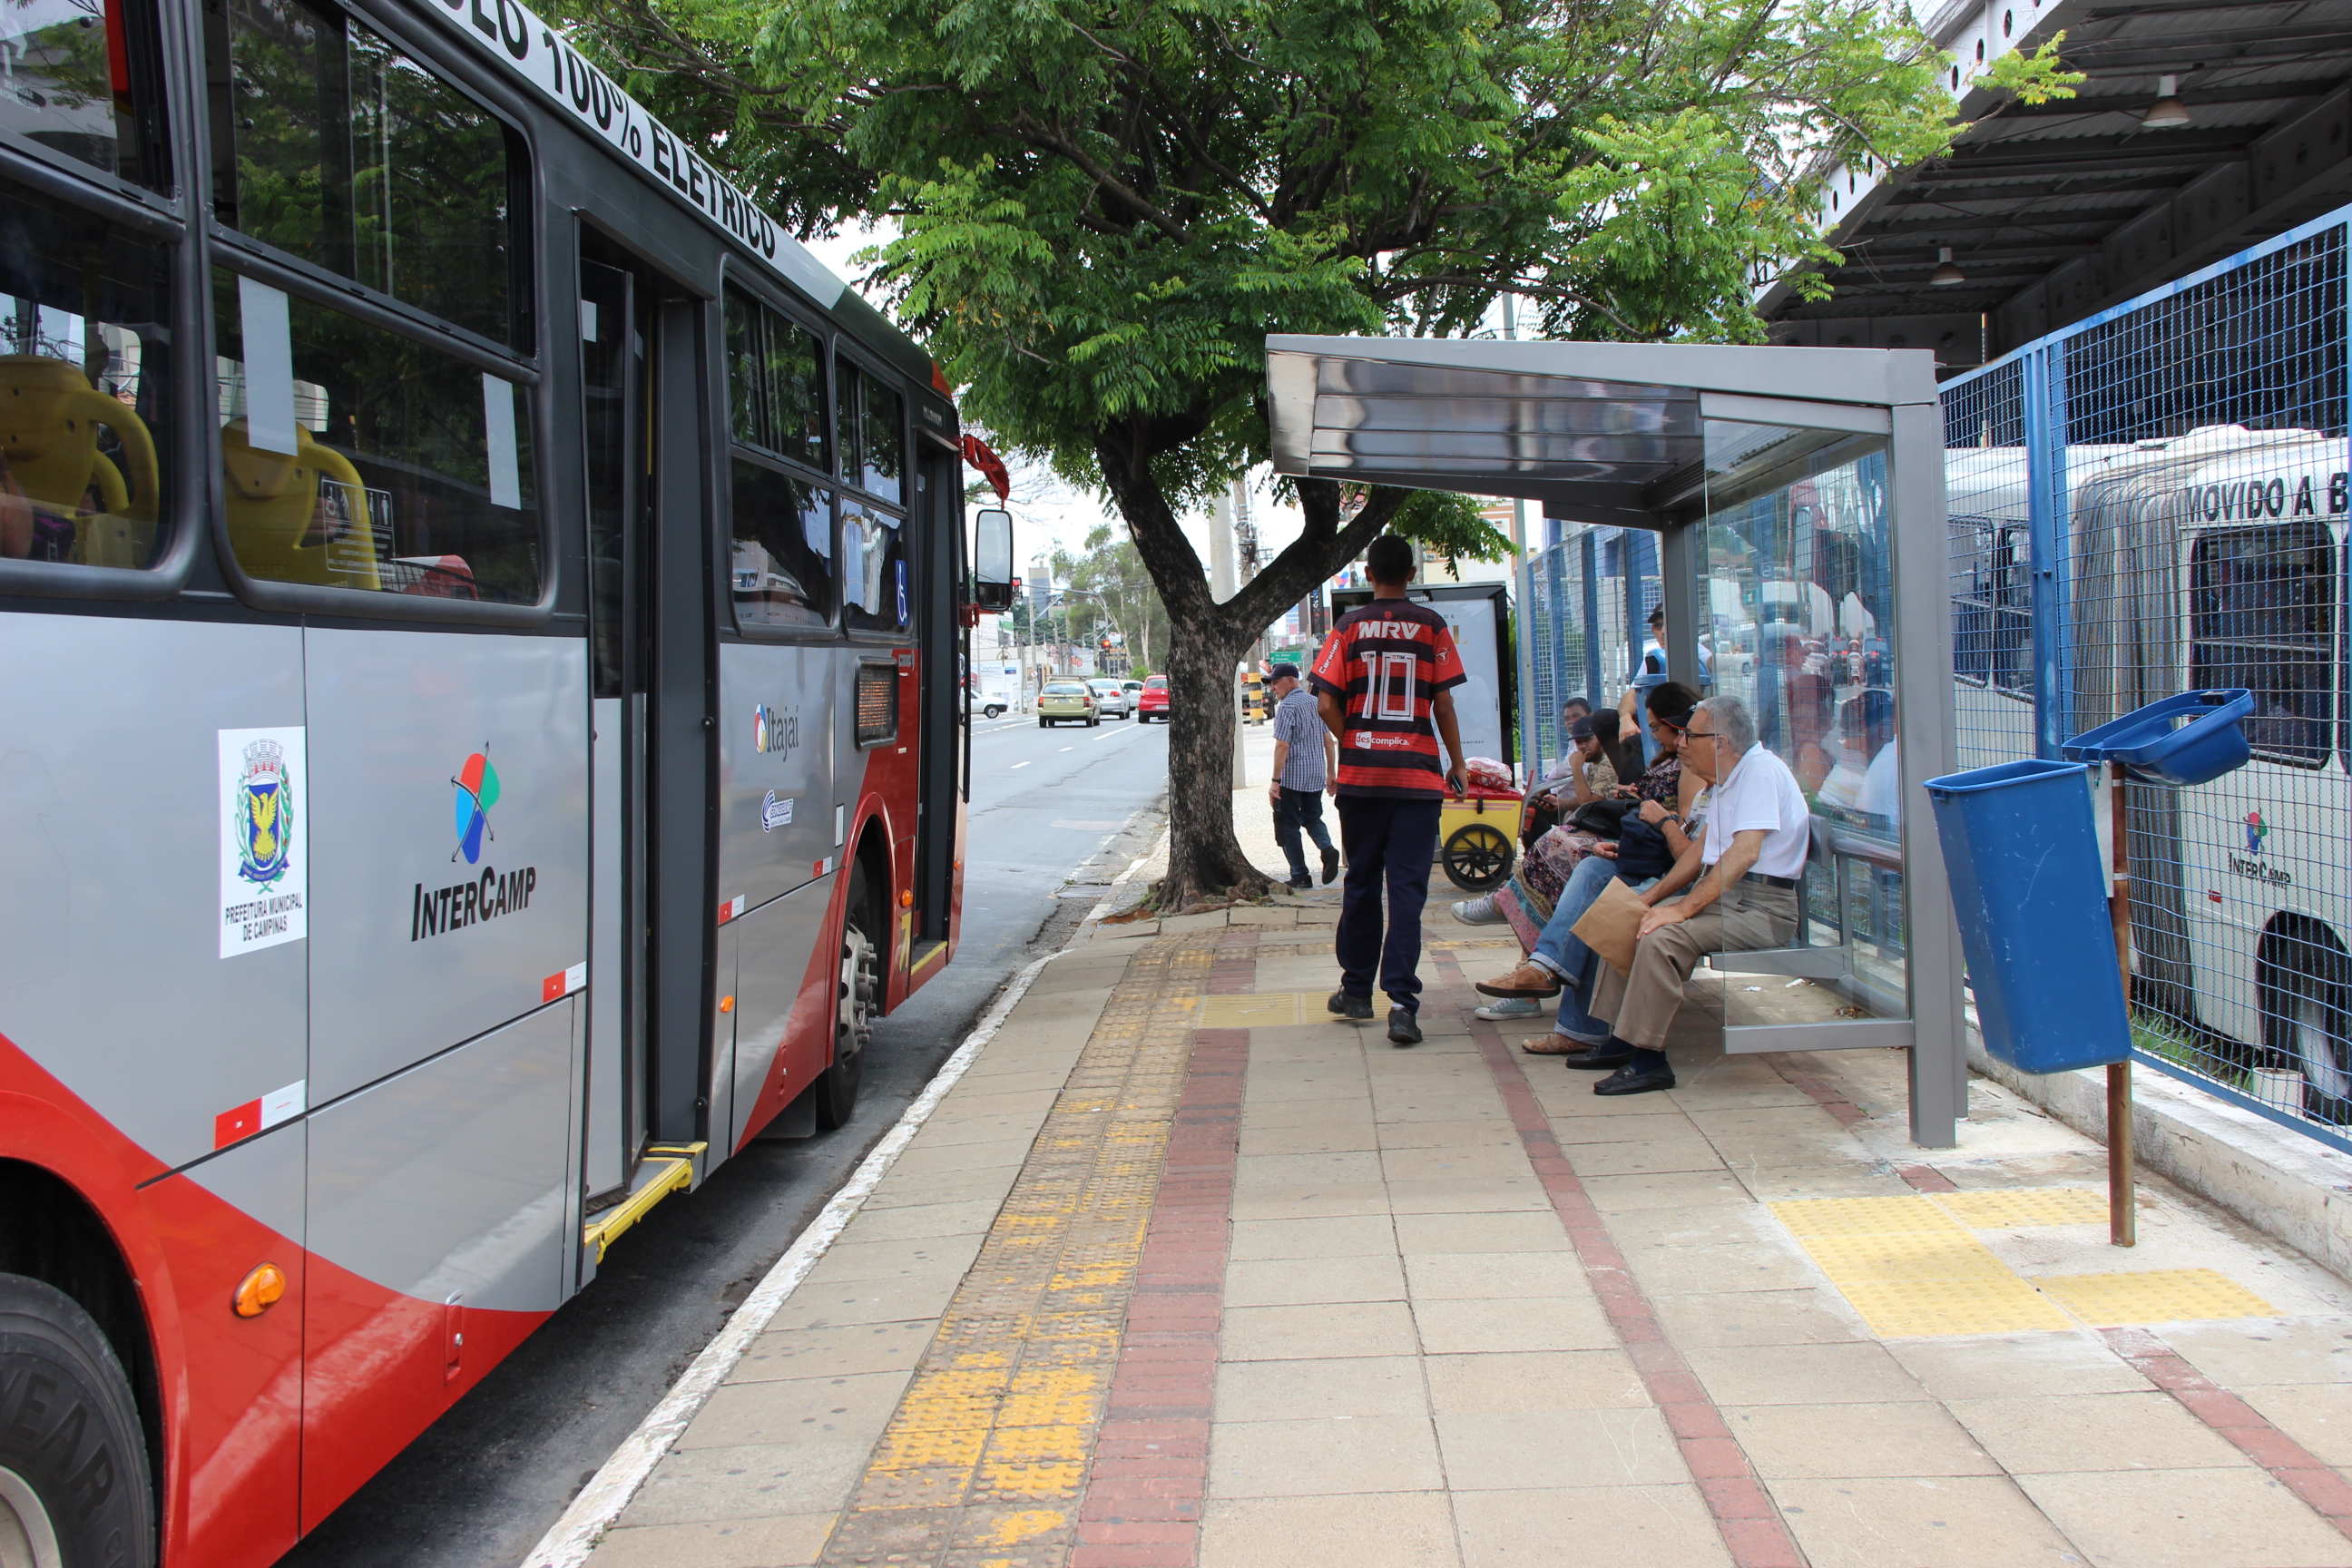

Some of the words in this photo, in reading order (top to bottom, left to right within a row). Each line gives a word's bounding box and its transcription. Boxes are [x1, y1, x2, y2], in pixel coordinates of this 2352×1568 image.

[544, 26, 642, 159] 100%
[648, 115, 776, 260] ELETRICO
[2184, 477, 2284, 523] MOVIDO
[2293, 475, 2314, 515] A
[1358, 621, 1422, 640] MRV
[1360, 651, 1416, 722] 10
[766, 704, 799, 763] Itajaí
[225, 899, 269, 926] PREFEITURA
[269, 892, 303, 916] MUNICIPAL
[243, 923, 252, 942] DE
[254, 915, 288, 939] CAMPINAS
